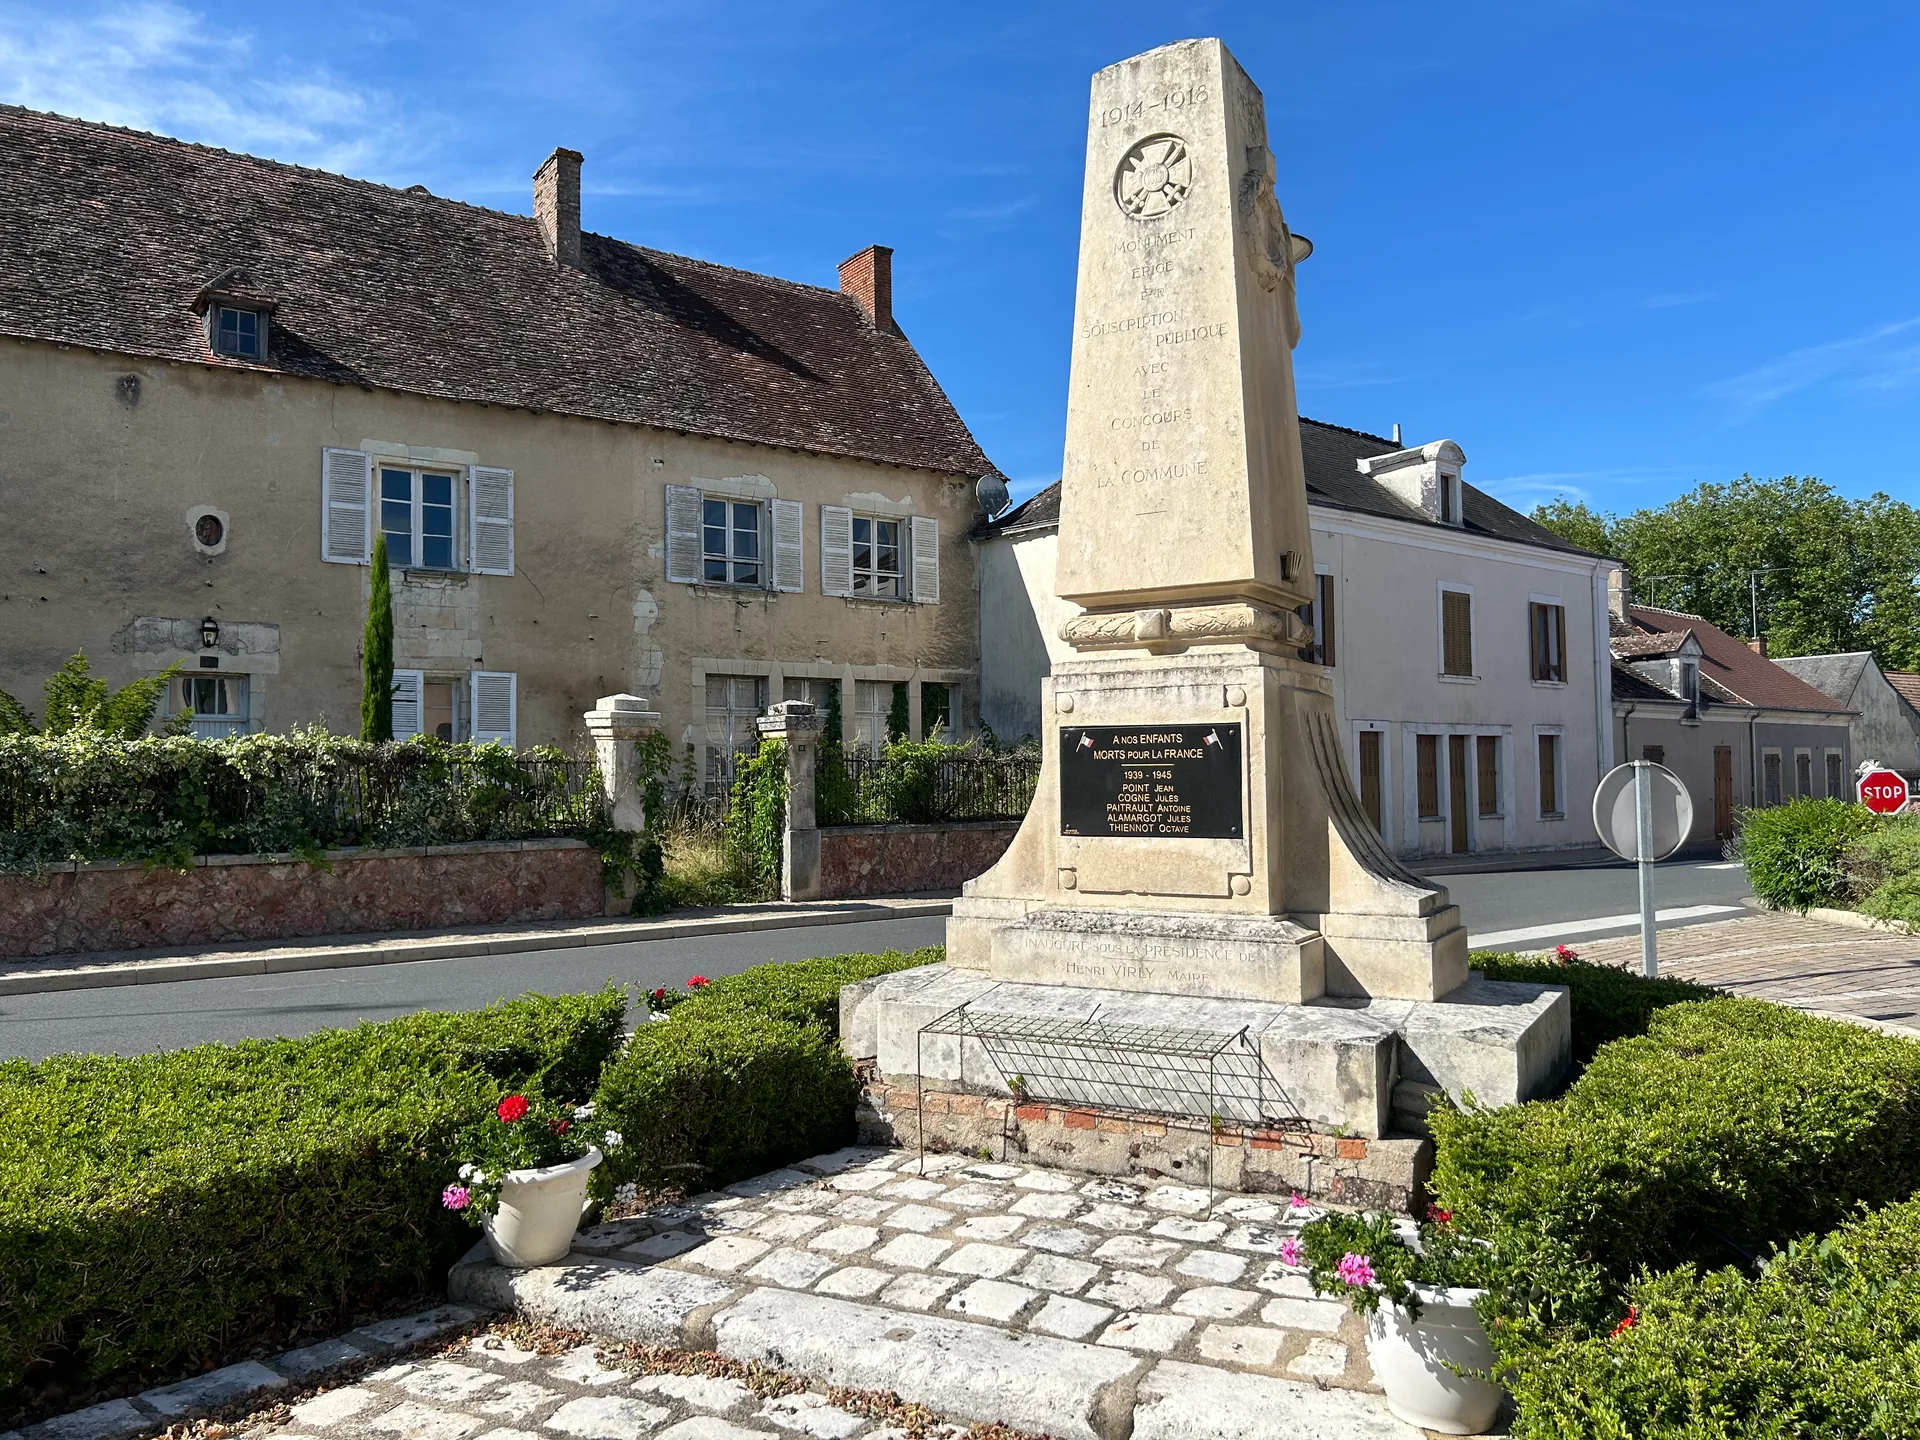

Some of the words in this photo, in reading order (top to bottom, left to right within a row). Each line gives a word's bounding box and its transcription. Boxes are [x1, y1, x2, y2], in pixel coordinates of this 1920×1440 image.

[1113, 228, 1196, 256] MONUMENT
[1082, 309, 1184, 339] SOUSCRIPTION
[1156, 322, 1229, 347] PUBLIQUE
[1132, 362, 1170, 377] AVEC
[1143, 388, 1161, 400] LE
[1110, 408, 1192, 431] CONCOURS
[1141, 440, 1160, 452] DE
[1097, 477, 1114, 488] LA
[1121, 461, 1208, 485] COMMUNE
[1112, 734, 1120, 744] A
[1121, 736, 1138, 744] NOS
[1139, 733, 1183, 744] ENFANTS
[1093, 750, 1125, 760] MORTS
[1127, 751, 1150, 759] POUR
[1151, 749, 1163, 759] LA
[1164, 748, 1203, 759] FRANCE
[1123, 771, 1143, 780] 1939
[1151, 770, 1172, 780] 1945
[1122, 784, 1149, 792] POINT
[1864, 785, 1902, 799] STOP
[1117, 793, 1150, 802] COGNE
[1106, 803, 1153, 812] PAITRAULT
[1106, 813, 1162, 823] ALAMARGOT
[1109, 823, 1154, 833] THIENNOT
[1093, 943, 1121, 953] SOUS
[1126, 945, 1140, 955] LA
[1239, 952, 1255, 962] DE
[1111, 964, 1155, 979] VIRLY
